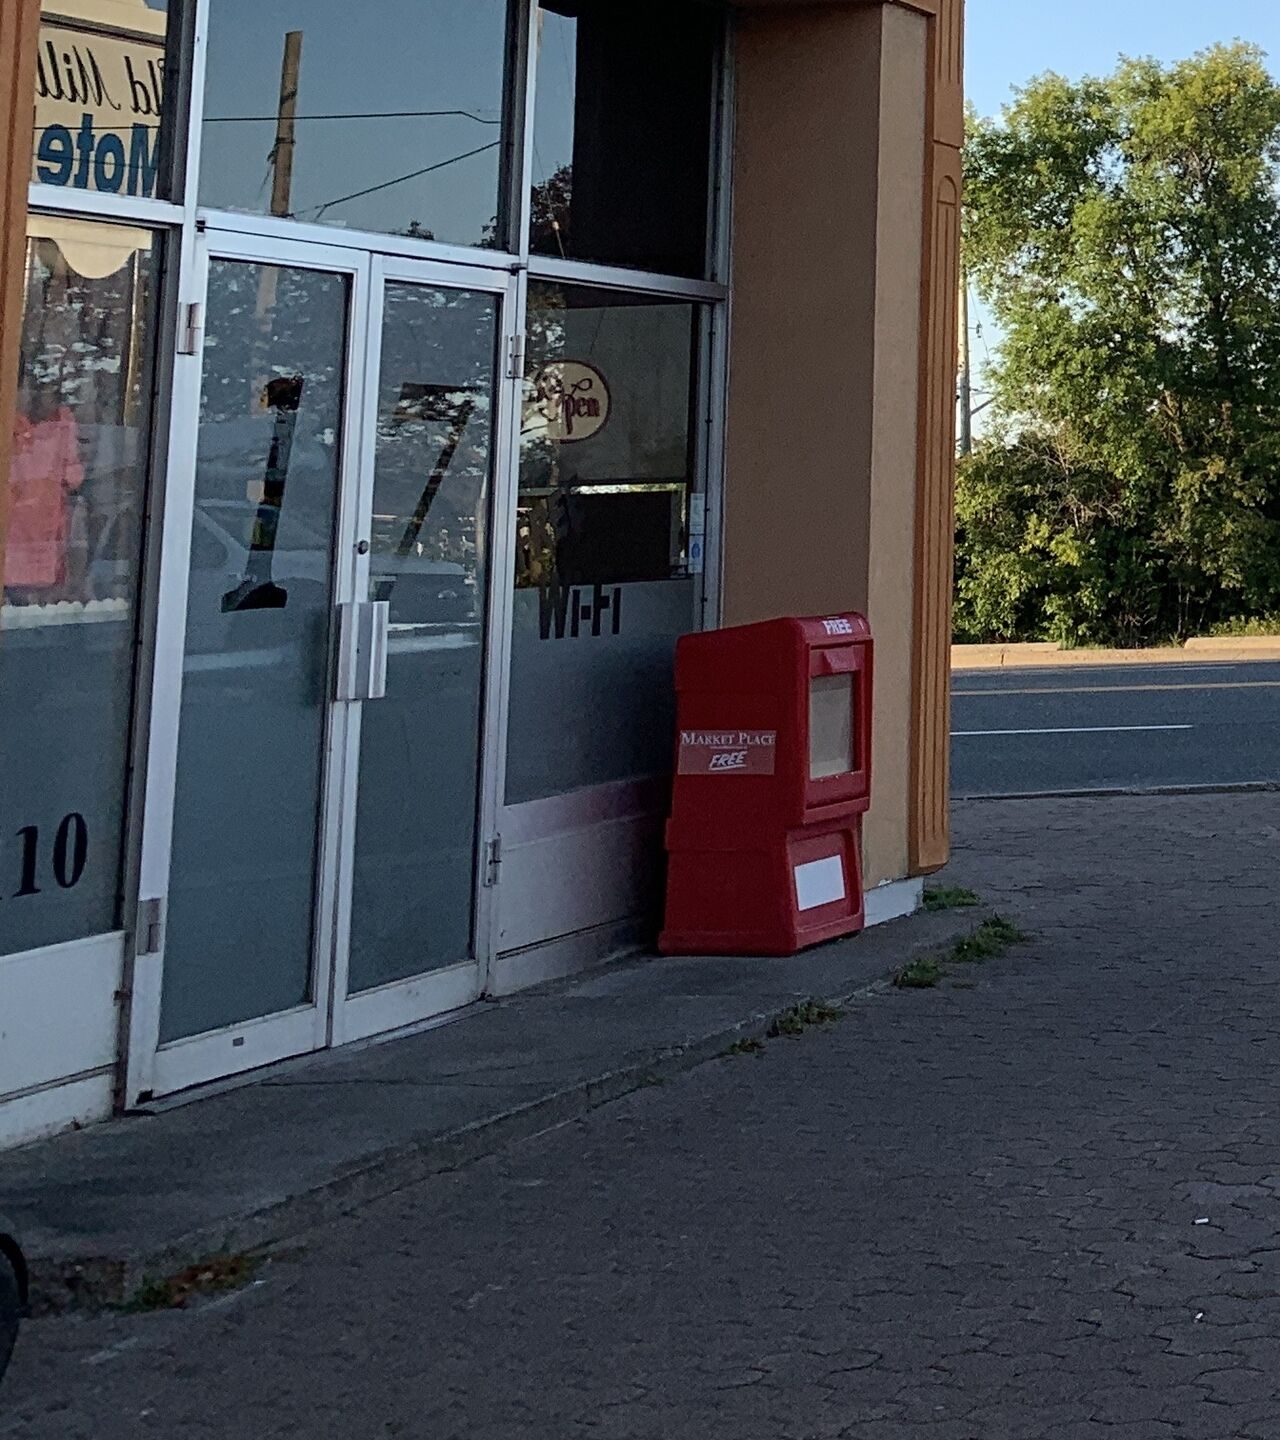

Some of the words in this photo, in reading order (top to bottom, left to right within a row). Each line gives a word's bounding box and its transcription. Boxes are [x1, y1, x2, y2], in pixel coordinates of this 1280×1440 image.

[822, 618, 853, 635] FREE
[680, 732, 735, 745] MARKET
[738, 732, 777, 745] PLACE
[709, 750, 748, 768] FREE
[0, 811, 88, 900] 10
